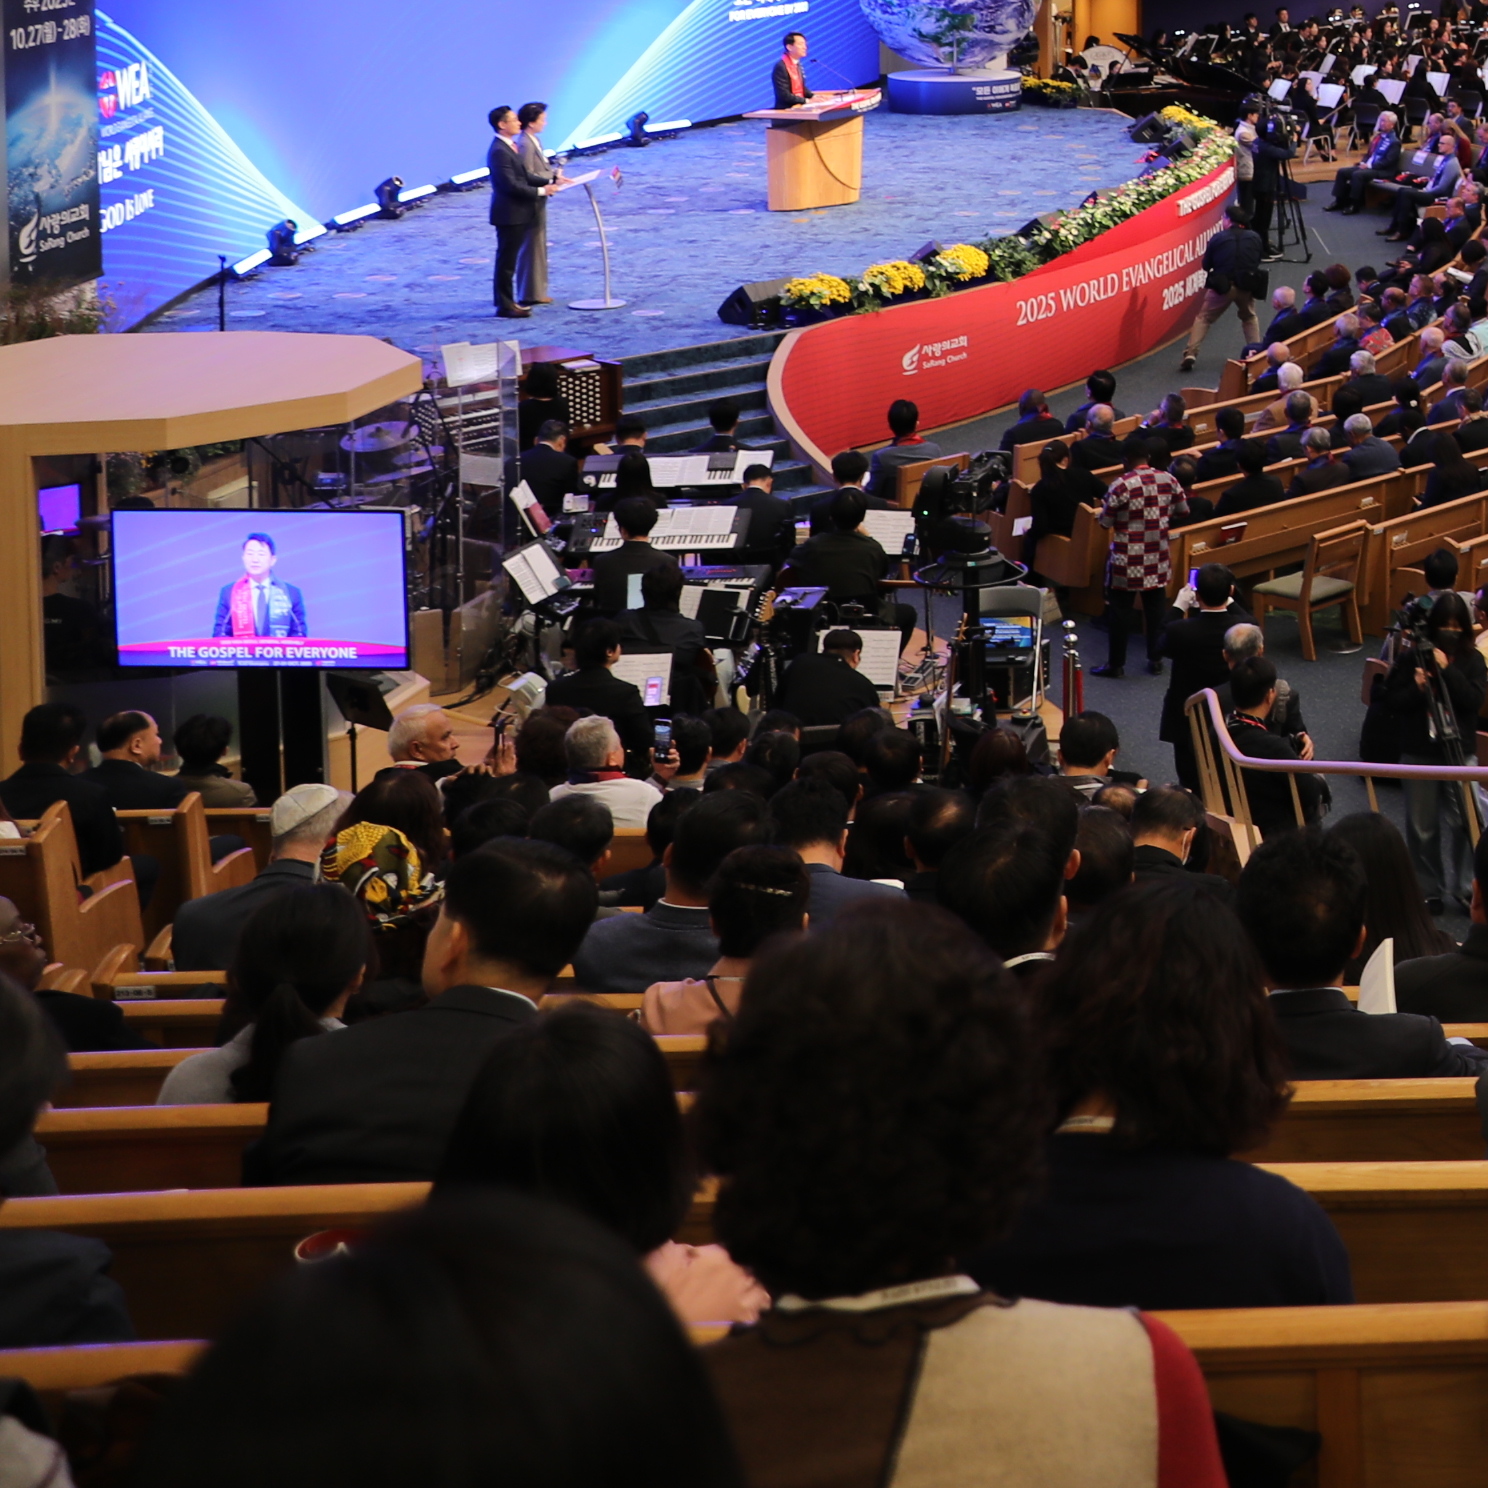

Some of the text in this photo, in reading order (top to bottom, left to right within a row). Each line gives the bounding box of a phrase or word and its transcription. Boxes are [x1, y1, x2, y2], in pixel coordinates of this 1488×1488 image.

[115, 60, 151, 110] WEA
[39, 203, 90, 234] 사랑의교회
[1016, 293, 1056, 326] 2025
[1058, 273, 1119, 312] WORLD
[1122, 240, 1195, 292] EVANGELICAL
[1162, 280, 1185, 311] 2025
[922, 335, 968, 356] 사랑의교회
[922, 352, 968, 370] SaRang Church
[167, 646, 358, 659] THE GOSPEL FOR EVERYONE
